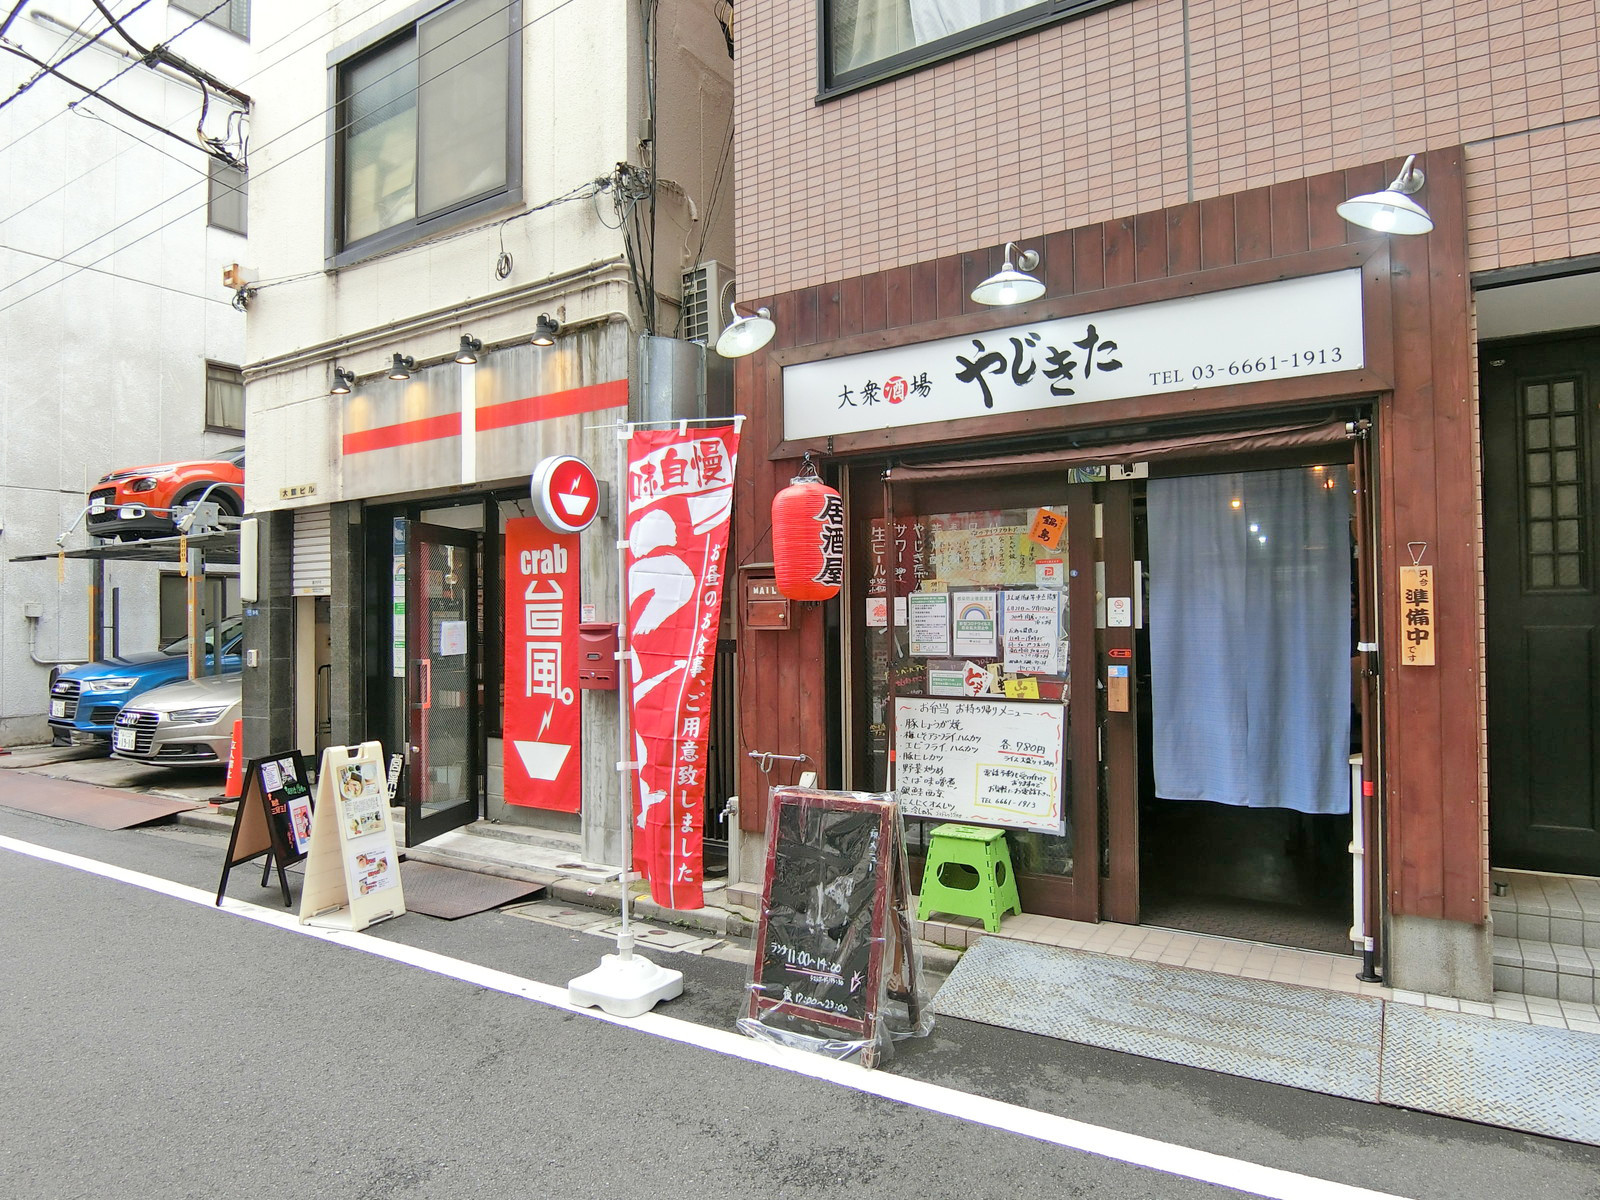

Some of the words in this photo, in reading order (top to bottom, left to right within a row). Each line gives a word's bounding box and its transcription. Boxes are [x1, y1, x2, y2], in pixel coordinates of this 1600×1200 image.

[955, 324, 1123, 409] やじきた
[1149, 370, 1184, 385] TEL
[1192, 347, 1342, 380] 03-6661-1913
[838, 372, 932, 409] 大衆酒場
[630, 440, 726, 503] 味自慢
[812, 493, 844, 587] 居酒屋
[894, 524, 907, 563] サワー
[520, 543, 568, 575] crab
[1419, 569, 1428, 586] 只今
[753, 586, 777, 595] MAIL
[1405, 588, 1430, 646] 準備中
[1408, 645, 1416, 662] です
[677, 543, 722, 884] お昼のお食事、ご用意致しました
[919, 701, 950, 715] お弁当
[955, 703, 1033, 717] お持ち帰りメニュー
[1016, 741, 1046, 755] 780円
[902, 763, 944, 775] 野菜炒め
